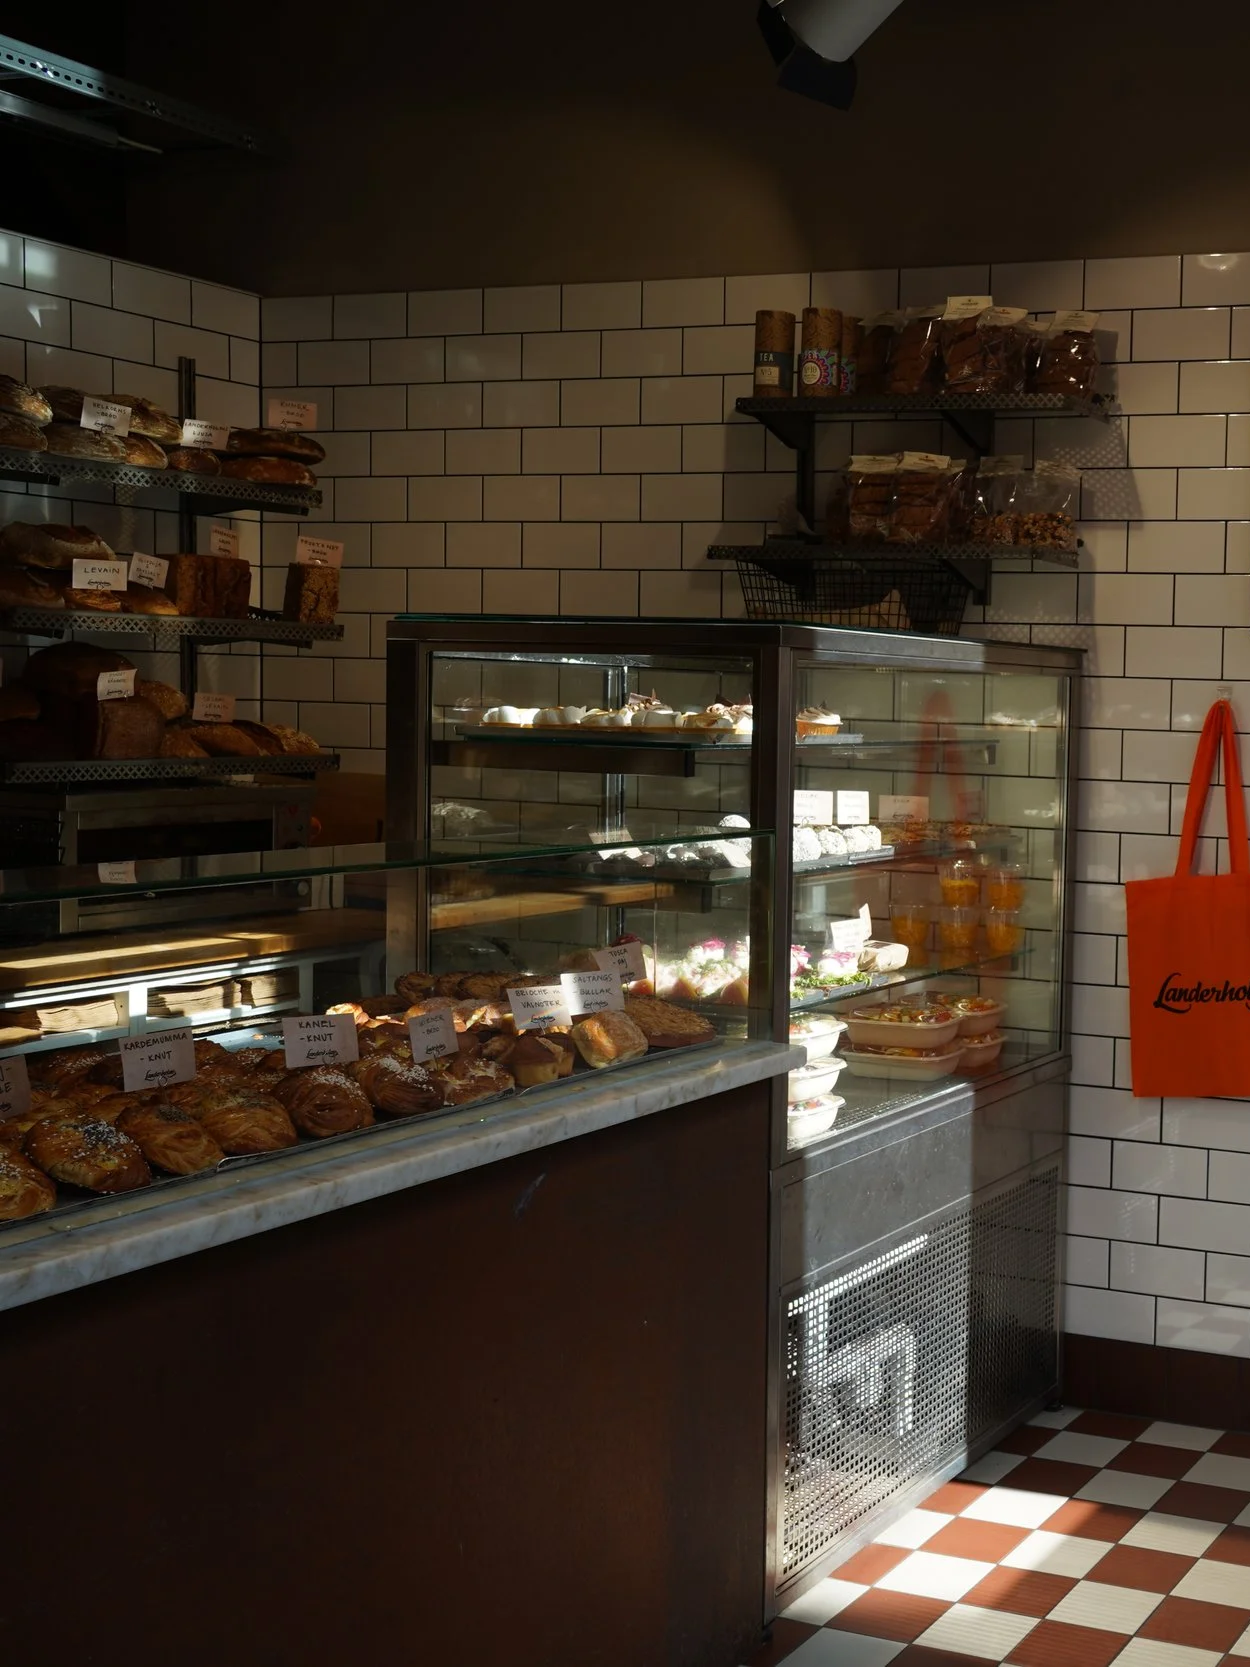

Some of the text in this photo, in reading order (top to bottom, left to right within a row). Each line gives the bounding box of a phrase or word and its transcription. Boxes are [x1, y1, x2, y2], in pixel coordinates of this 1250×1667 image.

[760, 353, 774, 362] TEA
[609, 948, 628, 957] TOSCA
[514, 989, 549, 997] BRIOCHE
[298, 1020, 336, 1029] KANEL
[123, 1031, 188, 1051] KARDEMUMMA
